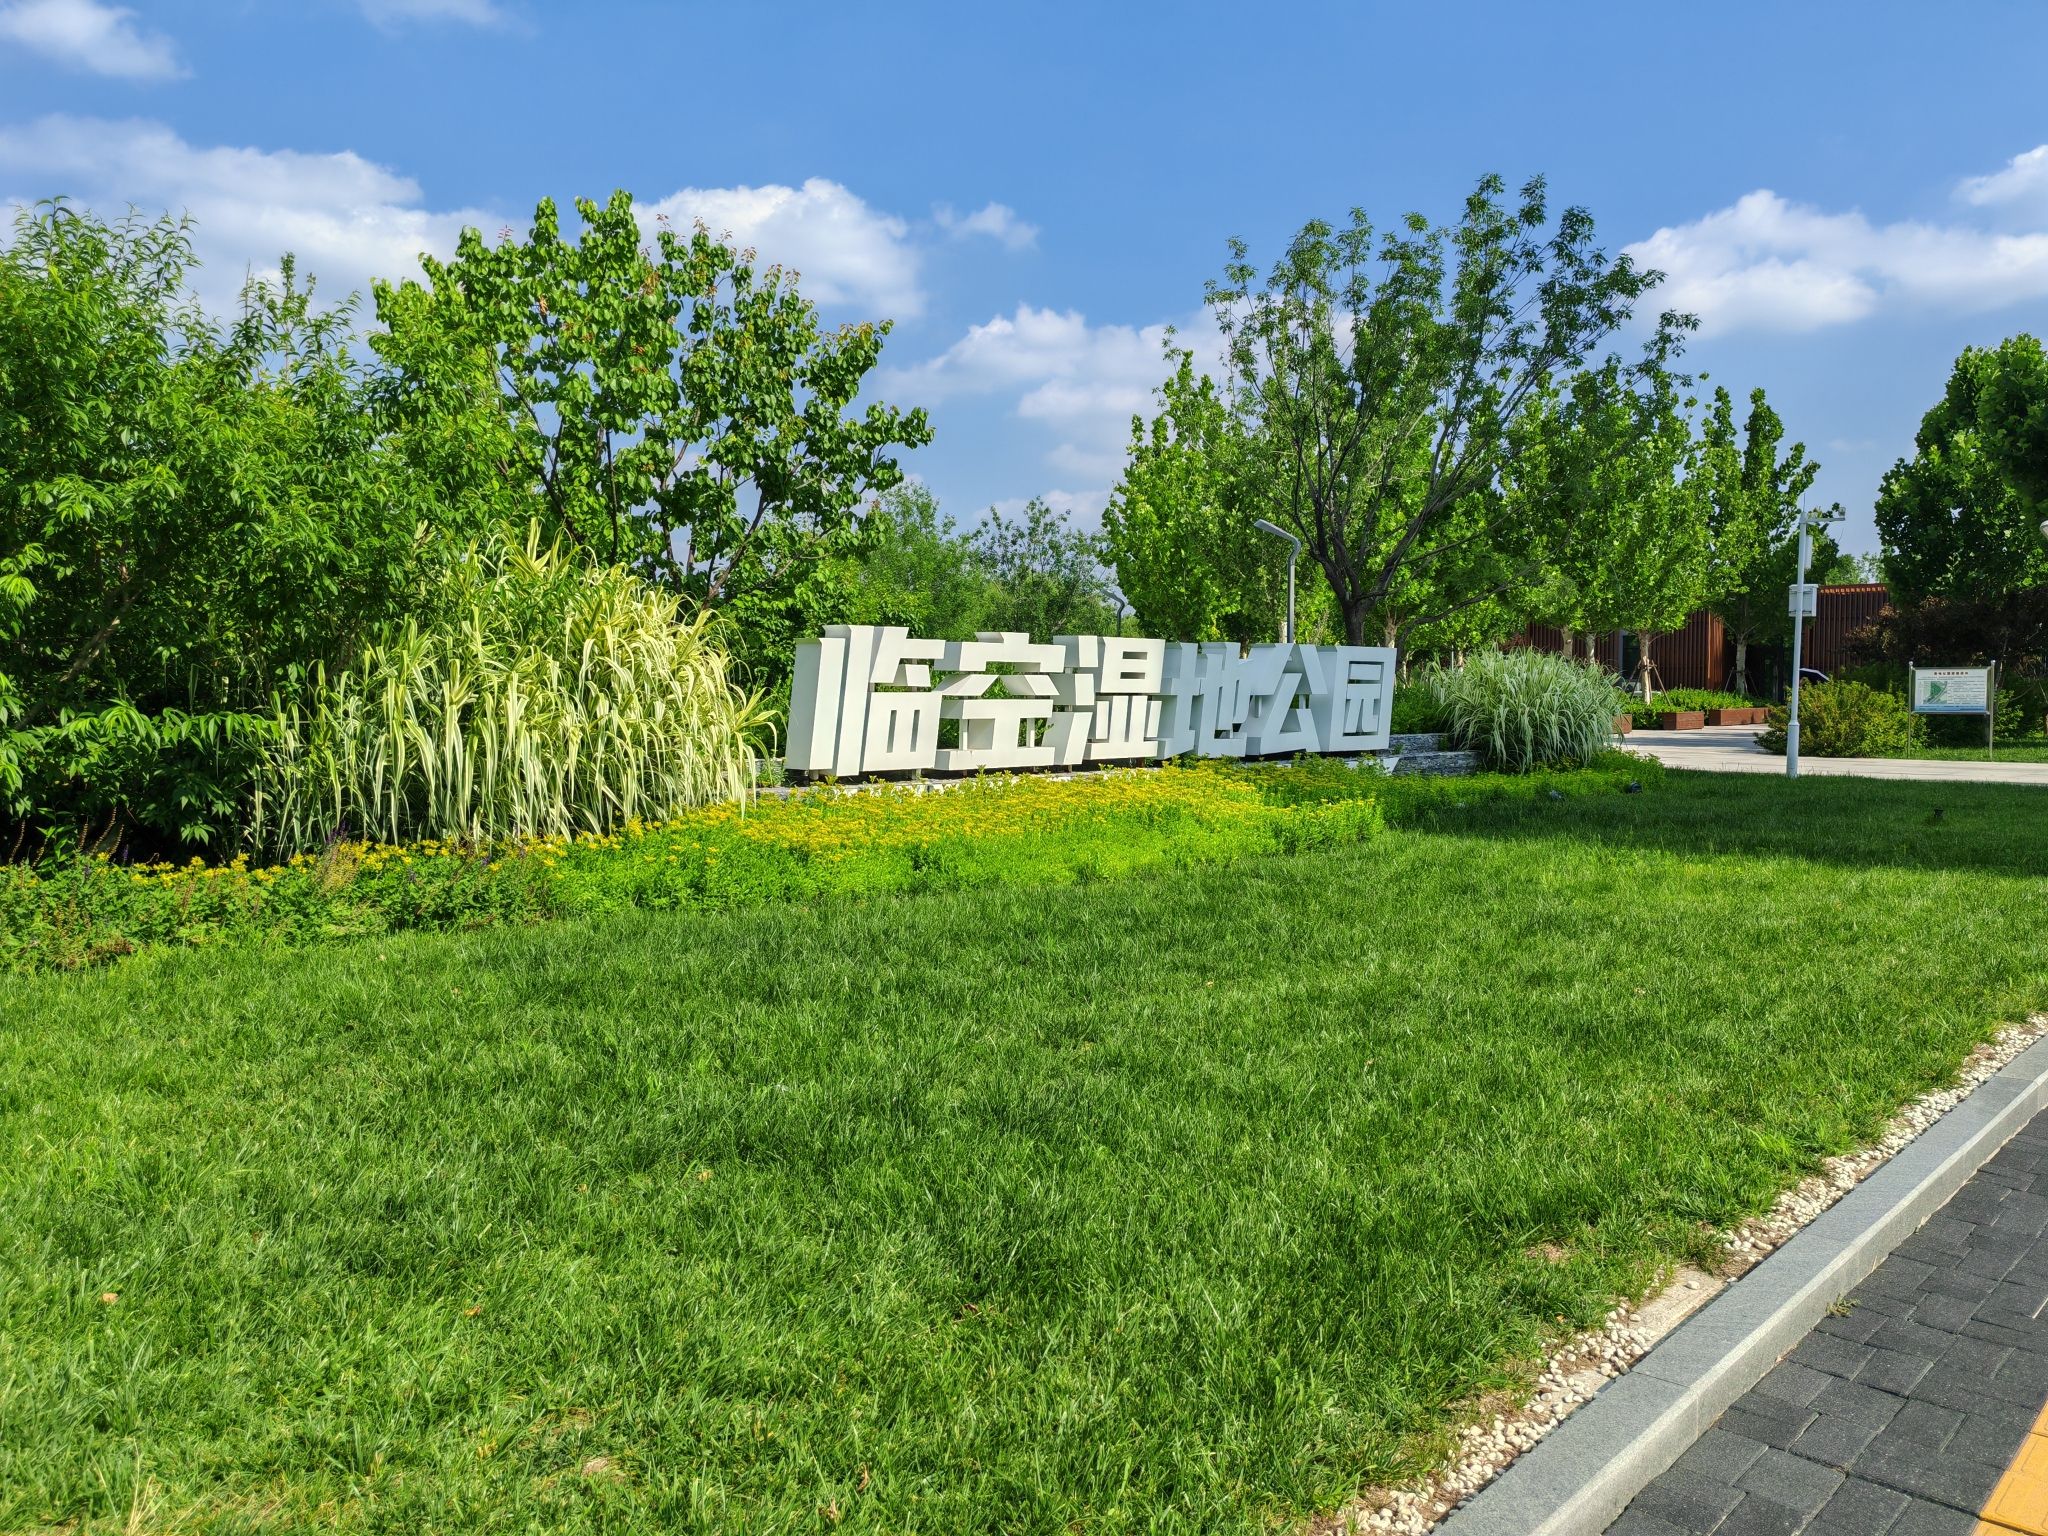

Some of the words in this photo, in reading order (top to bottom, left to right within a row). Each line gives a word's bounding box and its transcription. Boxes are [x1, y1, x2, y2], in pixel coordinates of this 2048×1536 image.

[787, 624, 1396, 776] 临空湿地公园
